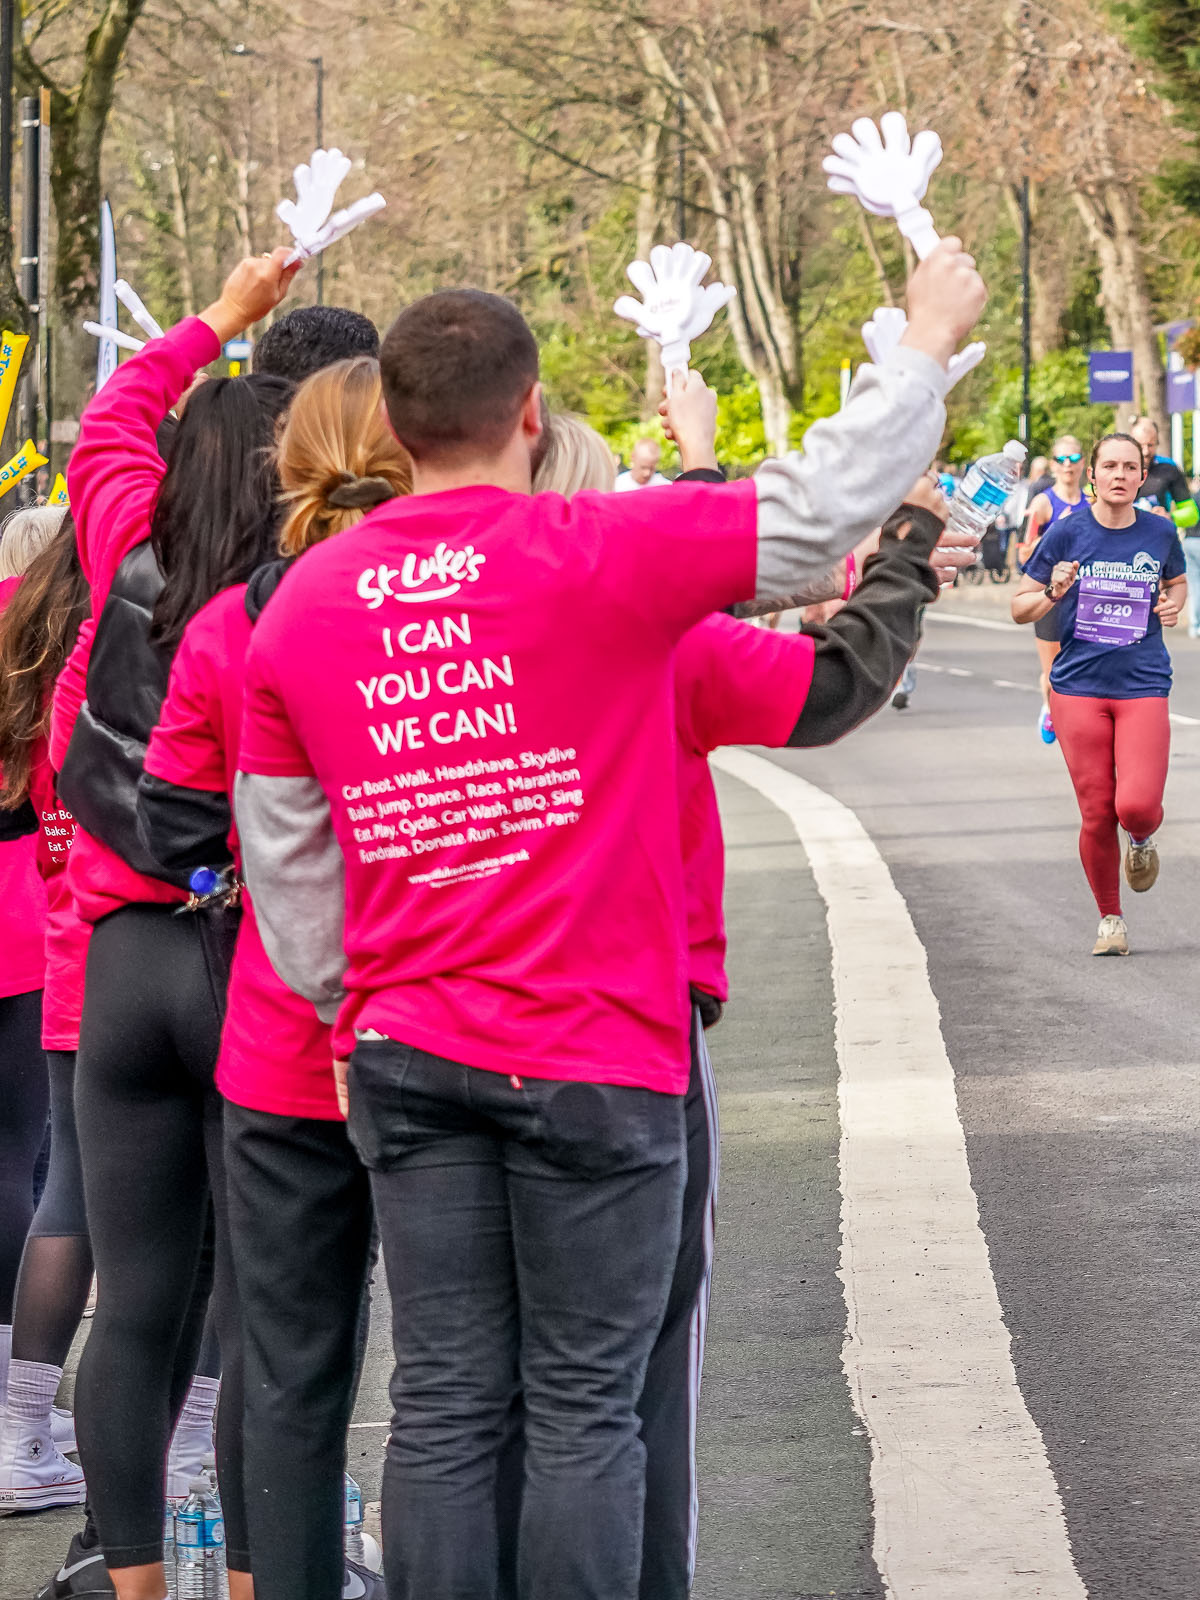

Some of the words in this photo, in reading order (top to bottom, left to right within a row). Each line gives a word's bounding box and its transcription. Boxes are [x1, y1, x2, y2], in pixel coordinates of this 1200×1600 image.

[0, 344, 13, 386] #Te
[0, 456, 27, 486] #Te
[357, 564, 400, 609] St
[401, 542, 486, 588] Luke's
[1093, 603, 1133, 618] 6820
[382, 627, 394, 658] I
[398, 613, 472, 653] CAN
[356, 667, 431, 709] YOU
[436, 655, 514, 695] CAN
[368, 716, 425, 756] WE
[429, 702, 518, 744] CAN!
[342, 785, 362, 801] Car
[362, 777, 396, 796] Boot.
[393, 768, 435, 789] Walk.
[434, 758, 519, 782] Headshave.
[519, 747, 576, 769] Skydive
[376, 798, 415, 819] Jump.
[415, 789, 466, 808] Dance.
[465, 782, 506, 799] Race.
[506, 768, 581, 793] Marathon
[42, 811, 57, 821] Car
[58, 809, 73, 820] Bo
[441, 809, 467, 825] Car
[466, 801, 511, 821] Wash.
[512, 794, 550, 813] BBQ.
[550, 789, 584, 807] Sing
[44, 826, 70, 836] Bake.
[48, 841, 66, 852] Eat.
[466, 826, 499, 843] Run.
[500, 817, 545, 836] Swim.
